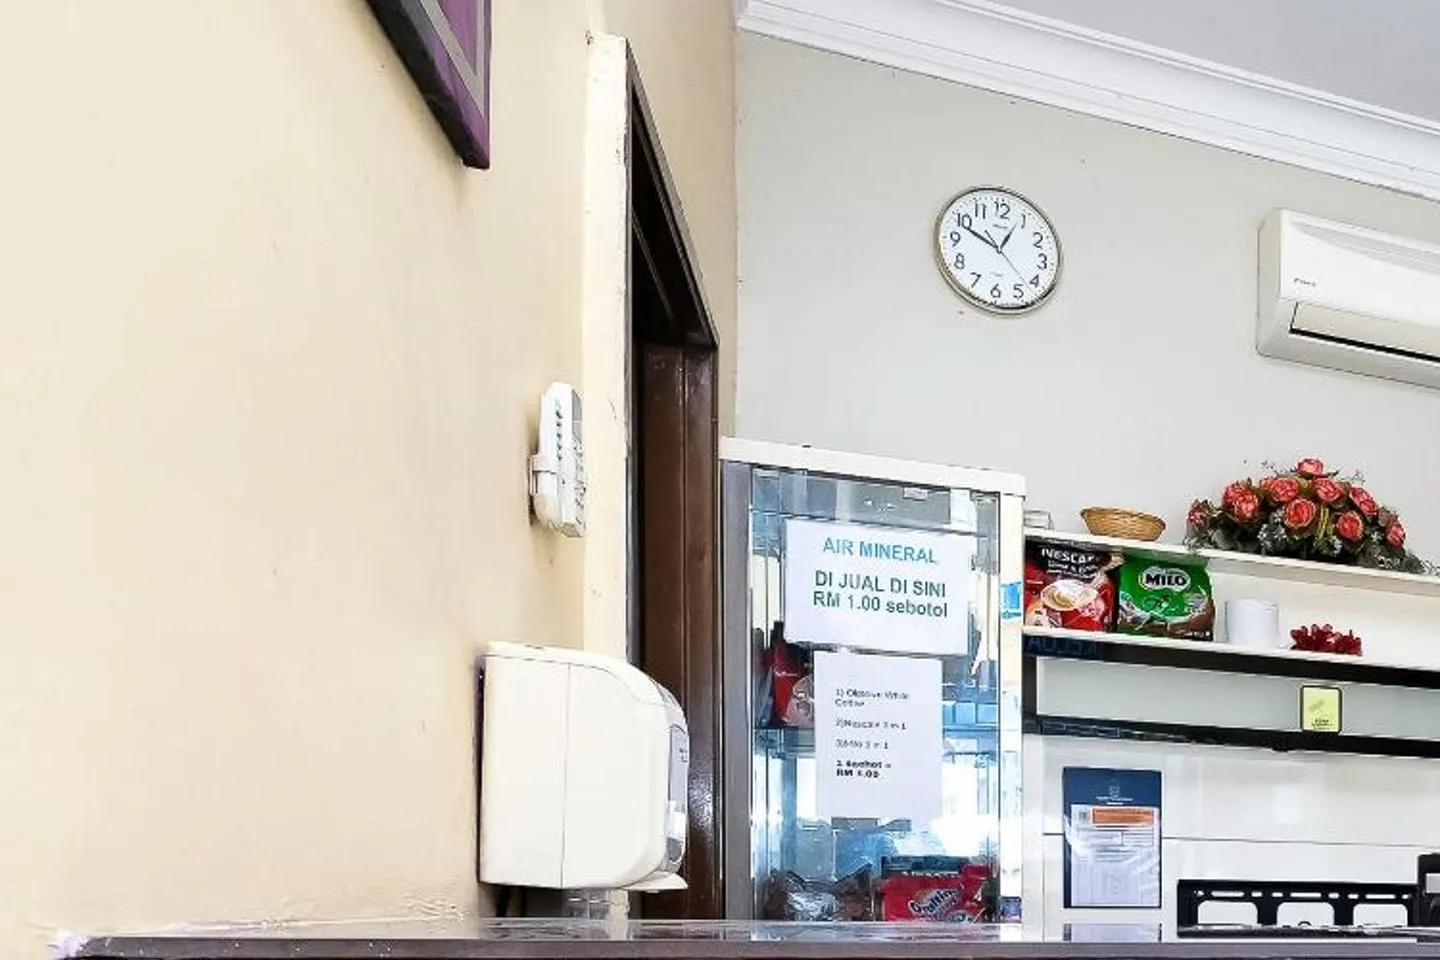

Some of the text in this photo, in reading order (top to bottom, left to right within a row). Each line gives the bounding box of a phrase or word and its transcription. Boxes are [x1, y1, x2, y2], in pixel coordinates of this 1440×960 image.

[974, 201, 986, 220] 11
[994, 201, 1010, 220] 12
[957, 213, 972, 229] 10
[950, 231, 961, 247] 9
[1032, 232, 1043, 249] 2
[954, 252, 965, 270] 8
[1037, 253, 1047, 270] 3
[970, 272, 982, 288] 7
[1029, 274, 1040, 288] 4
[990, 283, 1001, 298] 6
[1013, 283, 1024, 299] 5
[823, 537, 938, 564] AIR MINERAL
[815, 570, 946, 598] DI JUAL DI SINI
[1145, 573, 1187, 586] MILO
[813, 591, 948, 618] RM 1.00 sebotol
[836, 769, 853, 777] RM
